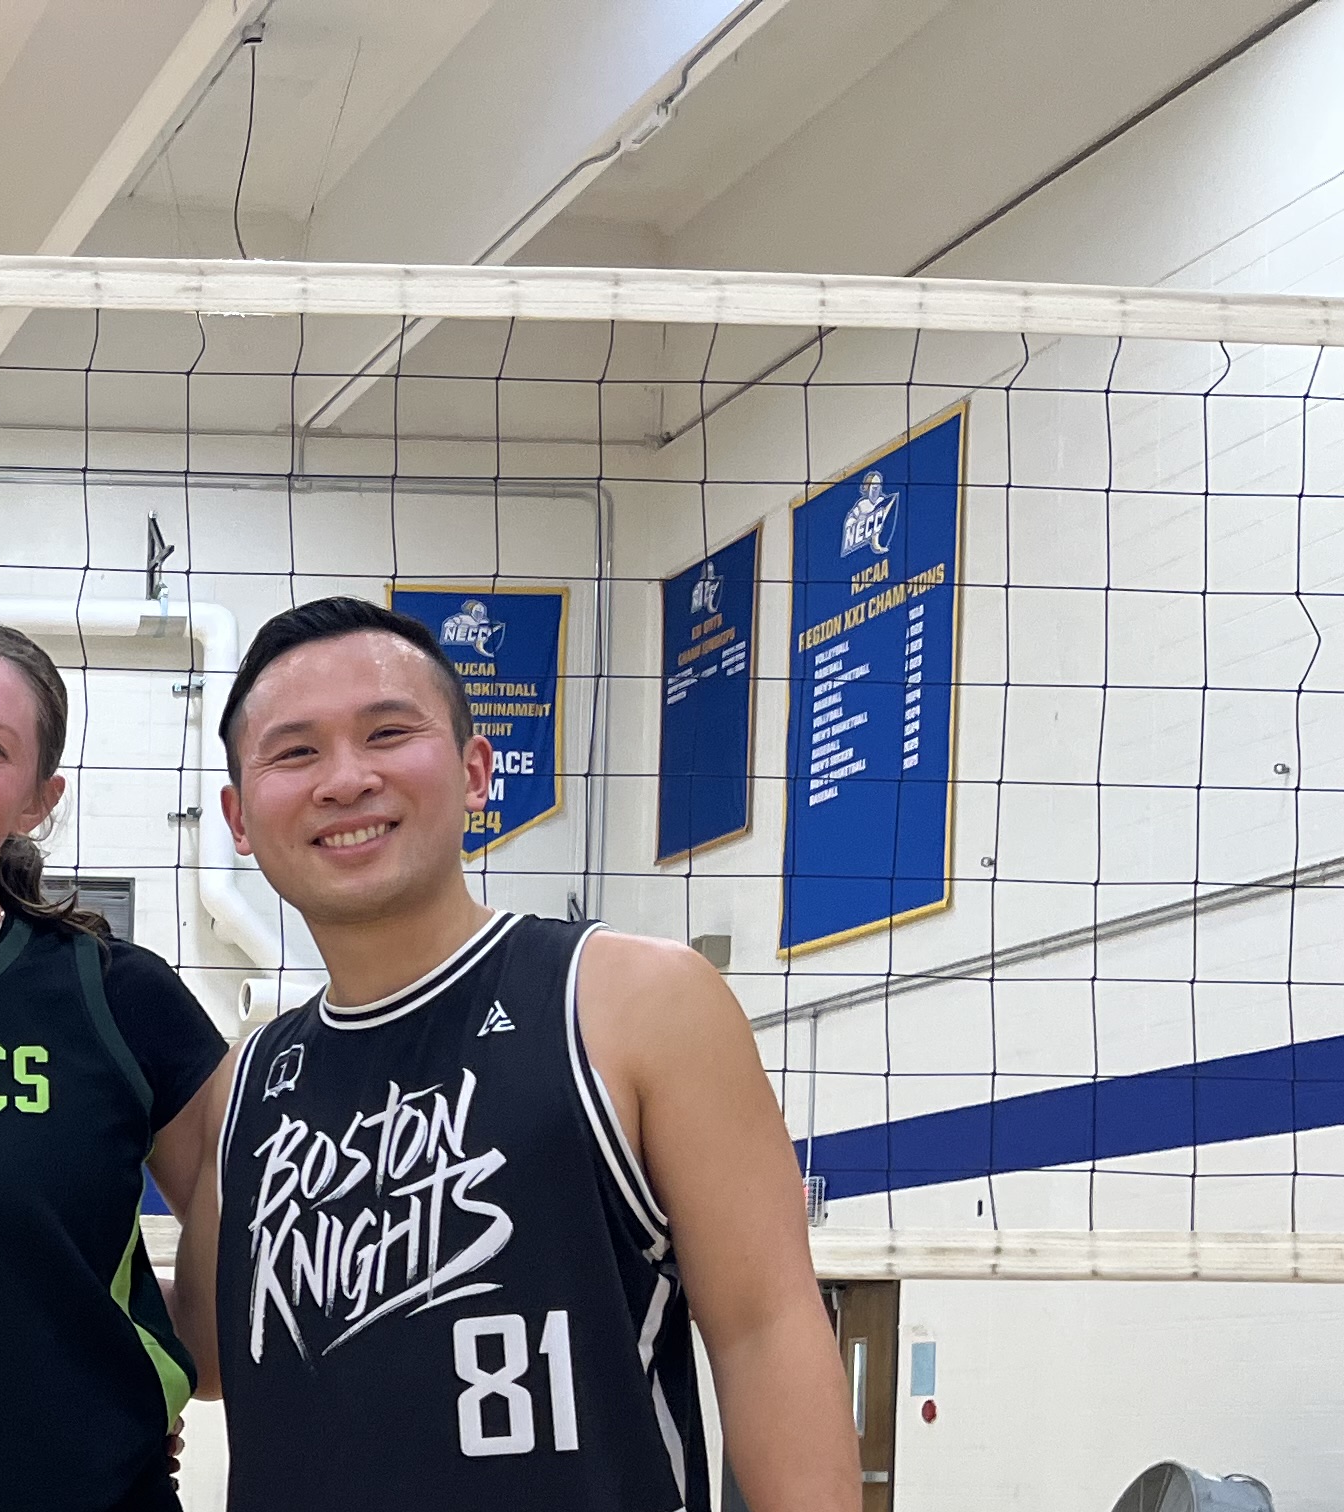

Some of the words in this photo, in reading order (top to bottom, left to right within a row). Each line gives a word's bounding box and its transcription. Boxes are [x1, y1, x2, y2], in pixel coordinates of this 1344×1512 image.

[443, 626, 492, 642] NECC
[464, 682, 538, 697] ASKETBALL
[470, 702, 551, 718] OURNAMENT
[492, 750, 534, 774] ACE
[452, 1310, 579, 1457] 81
